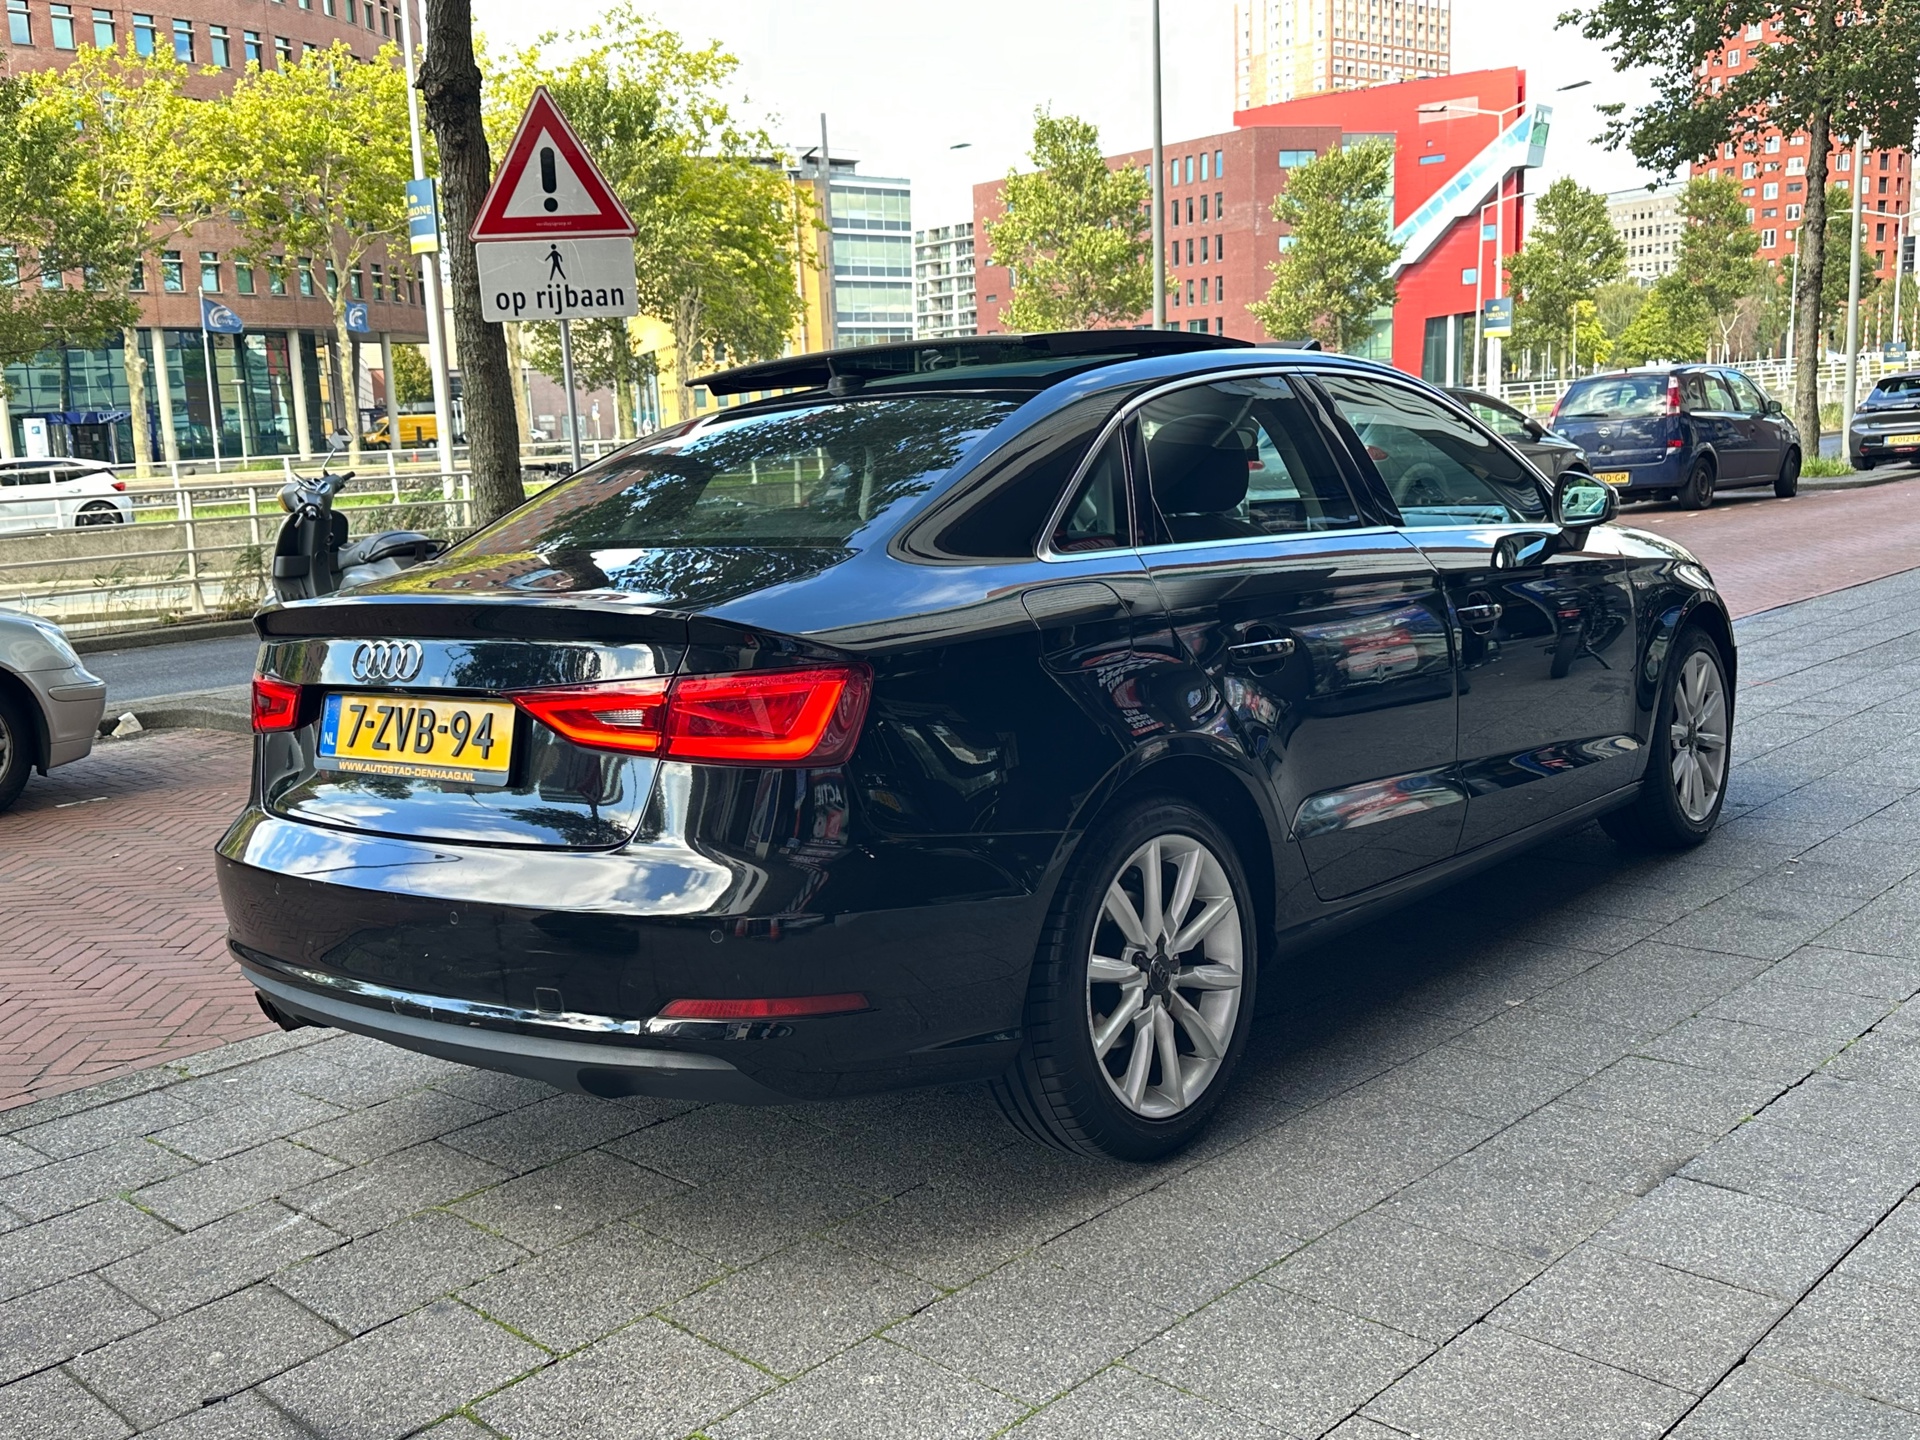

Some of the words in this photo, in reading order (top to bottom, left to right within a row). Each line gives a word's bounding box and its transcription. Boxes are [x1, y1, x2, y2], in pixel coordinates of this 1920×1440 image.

[496, 291, 526, 317] op
[536, 284, 625, 315] rijbaan
[323, 731, 335, 746] NL
[346, 704, 494, 760] 7-ZVB-94
[338, 761, 476, 782] WWW.AUTOSTAD-DENHAAG.NL
